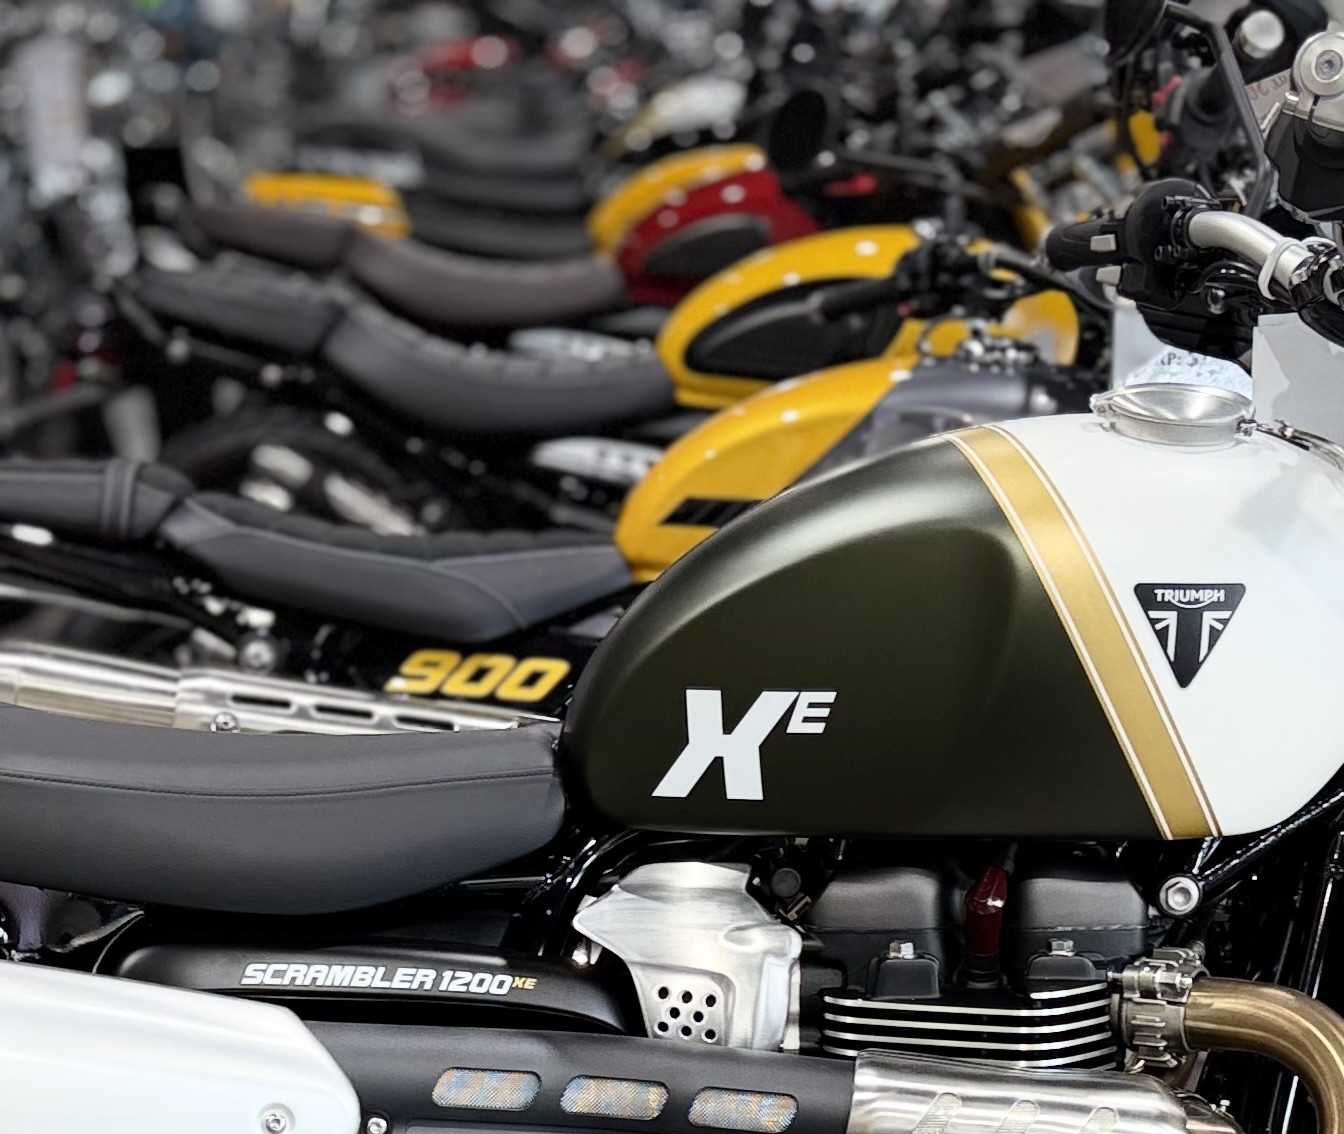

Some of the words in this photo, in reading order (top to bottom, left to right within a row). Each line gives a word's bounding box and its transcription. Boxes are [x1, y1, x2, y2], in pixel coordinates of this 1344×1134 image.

[1154, 589, 1226, 609] TRIUMPH
[384, 648, 571, 703] 900
[241, 963, 437, 990] SCRAMBLER
